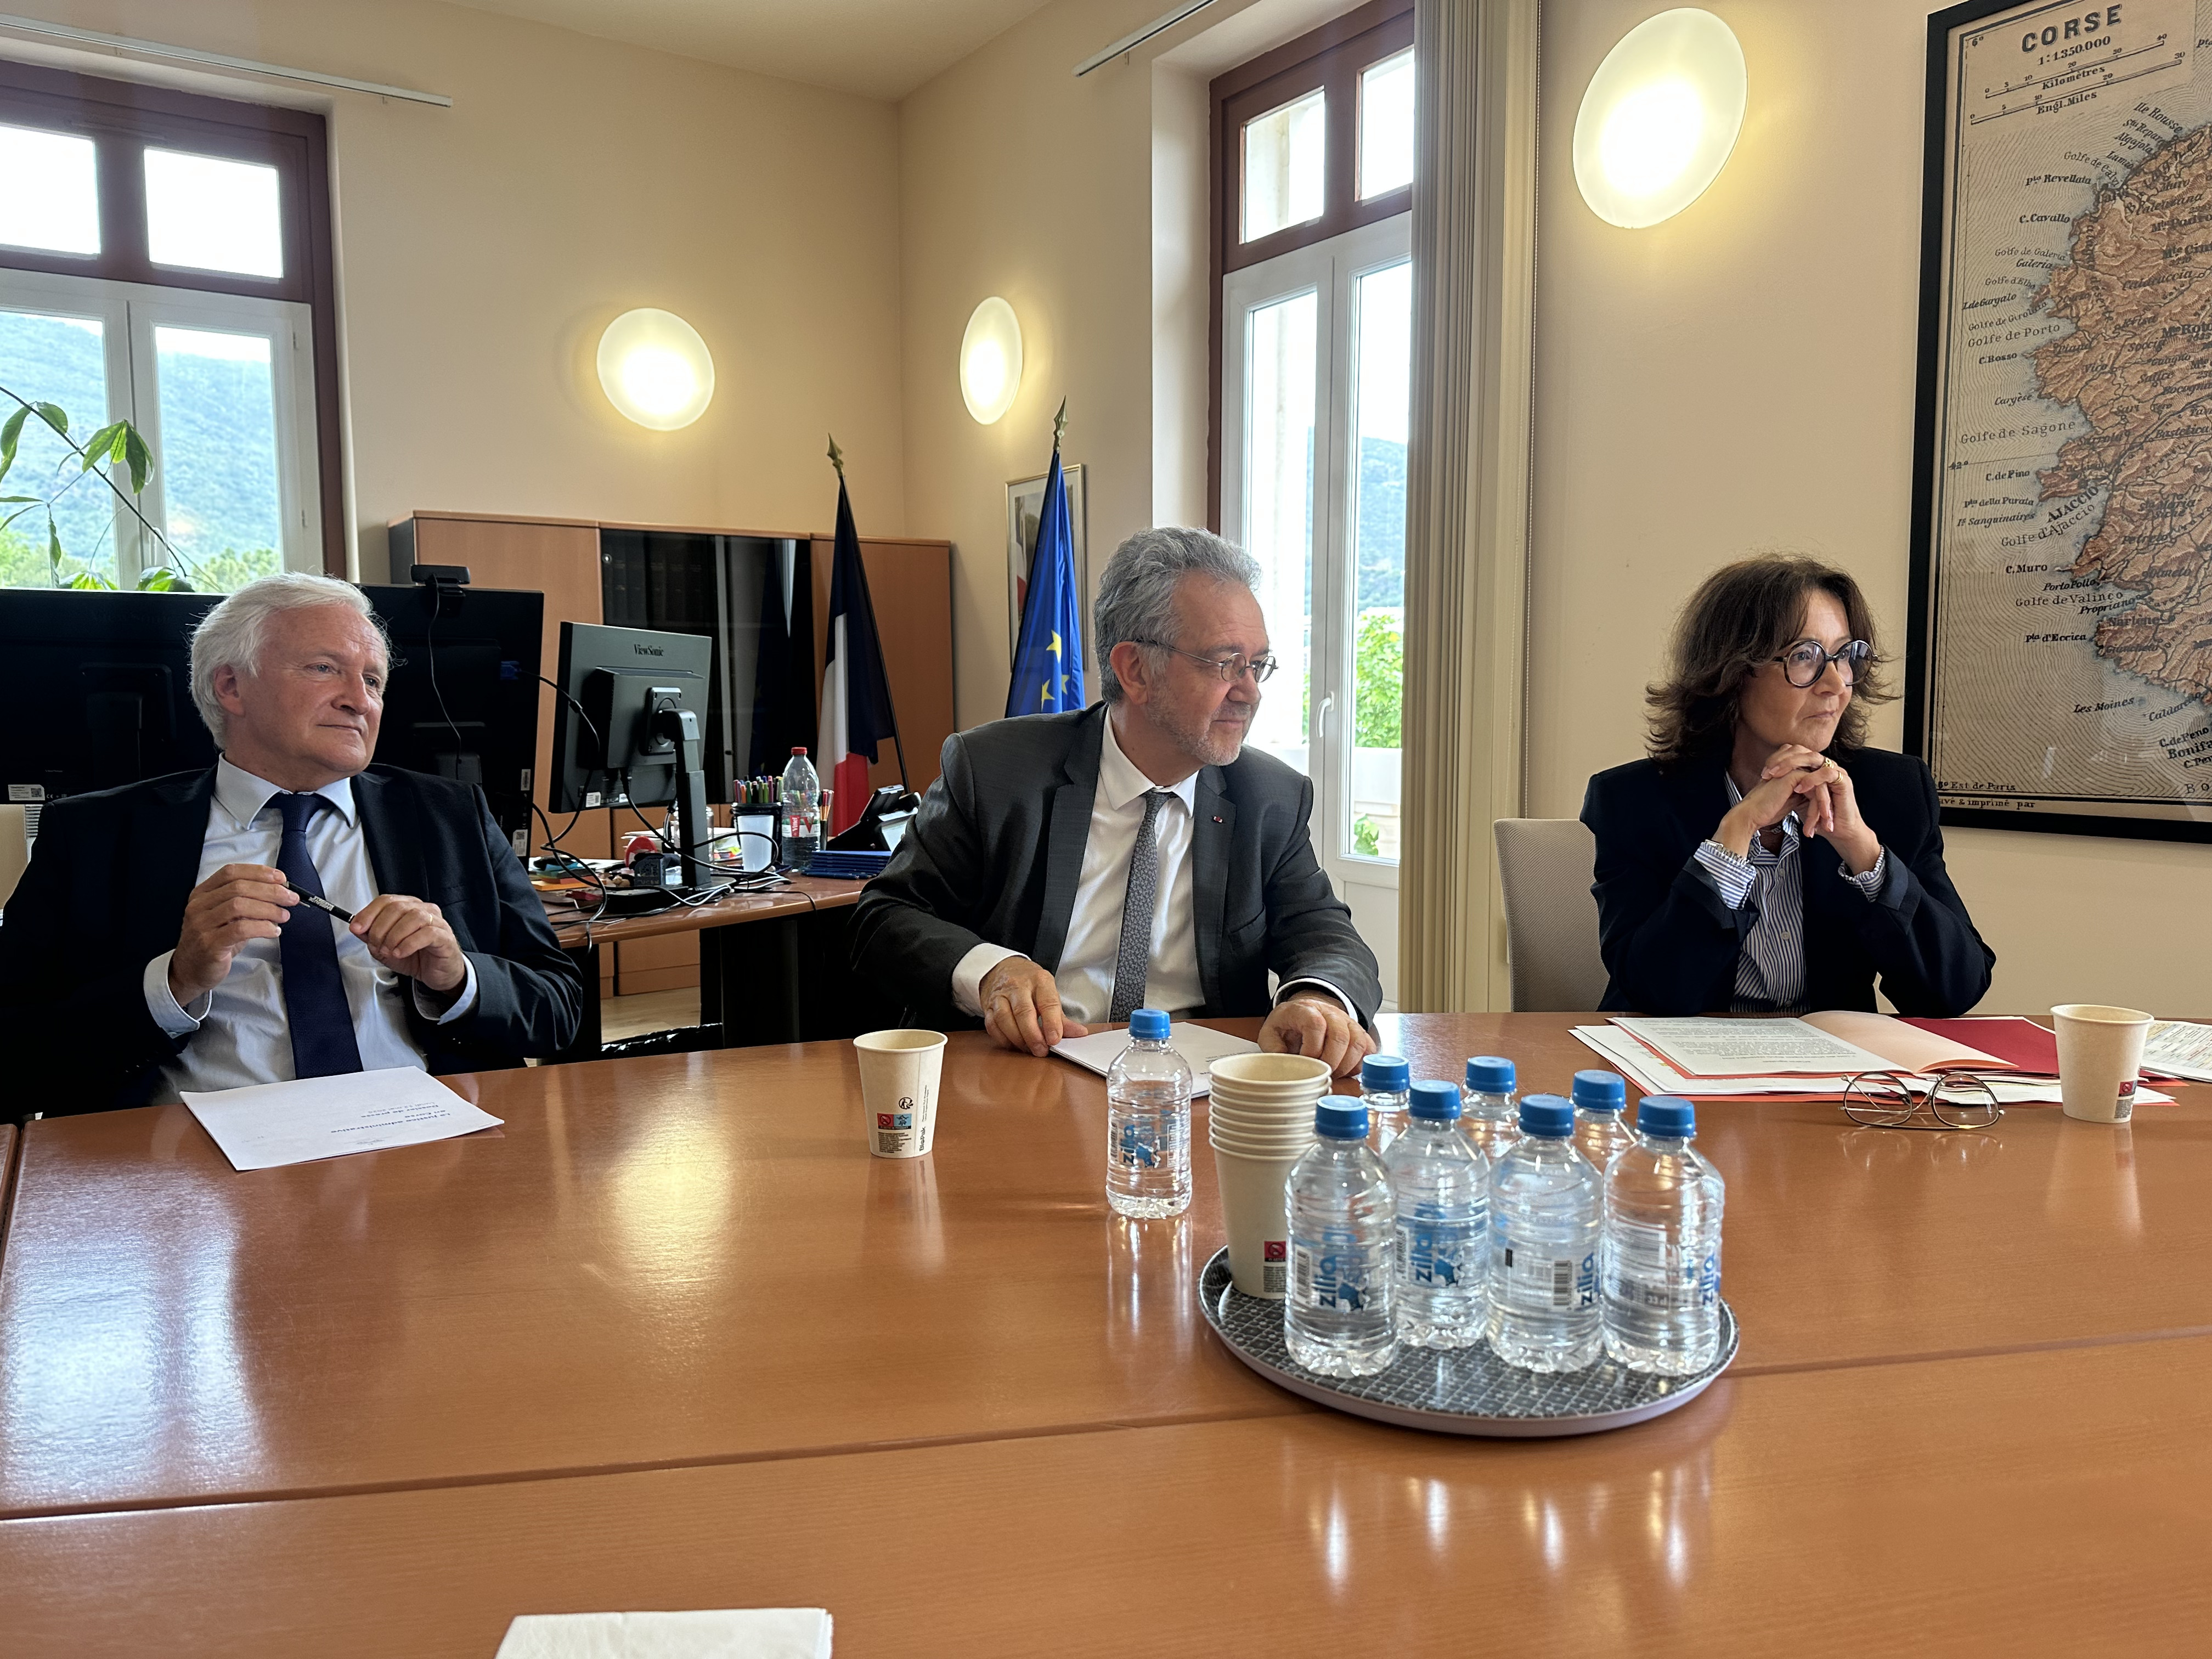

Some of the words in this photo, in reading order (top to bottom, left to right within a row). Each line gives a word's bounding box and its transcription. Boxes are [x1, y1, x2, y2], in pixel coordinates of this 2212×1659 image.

[2022, 4, 2122, 53] CORSE
[2157, 33, 2167, 42] 40
[2042, 65, 2106, 90] Kilomètres
[2133, 102, 2149, 114] Ile
[2148, 107, 2183, 133] Rousse
[2114, 132, 2154, 154] Algajola
[2064, 151, 2090, 163] Golfe
[2090, 158, 2102, 168] de
[2101, 165, 2124, 187] Calvi
[2106, 151, 2134, 170] Lumio
[2044, 173, 2092, 184] Revellata
[1995, 247, 2019, 257] Golfe
[2021, 247, 2031, 255] de
[2034, 248, 2066, 261] Galeria
[2016, 258, 2053, 269] Galeria
[1985, 276, 2008, 285] Golfe
[1968, 321, 1994, 331] Golfe
[1995, 318, 2006, 326] de
[1968, 336, 2002, 348] Golfe
[2005, 331, 2021, 341] de
[2024, 324, 2060, 337] Porto
[1961, 431, 1995, 444] Golfe
[1999, 428, 2015, 438] de
[2022, 421, 2075, 437] Sagone
[1979, 498, 2001, 507] della
[2046, 486, 2100, 523] AJACCIO
[1968, 512, 2035, 529] Sanguinaires
[2001, 534, 2035, 546] Golfe
[2038, 504, 2095, 539] d'Ajaccio
[2016, 597, 2049, 607] Golfe
[2052, 595, 2068, 605] de
[2069, 592, 2123, 603] Valinco
[634, 644, 664, 656] ViewSonic
[2073, 704, 2092, 713] Les
[2095, 697, 2135, 711] Moines
[1987, 782, 2016, 791] Paris
[1968, 798, 2010, 809] imprimé
[2017, 801, 2035, 810] par
[331, 1120, 404, 1134] administrative
[406, 1114, 437, 1123] justice
[1410, 1233, 1432, 1283] zilia
[1316, 1256, 1336, 1308] zilia
[1576, 1252, 1594, 1306] zilia
[1700, 1254, 1714, 1305] zilia
